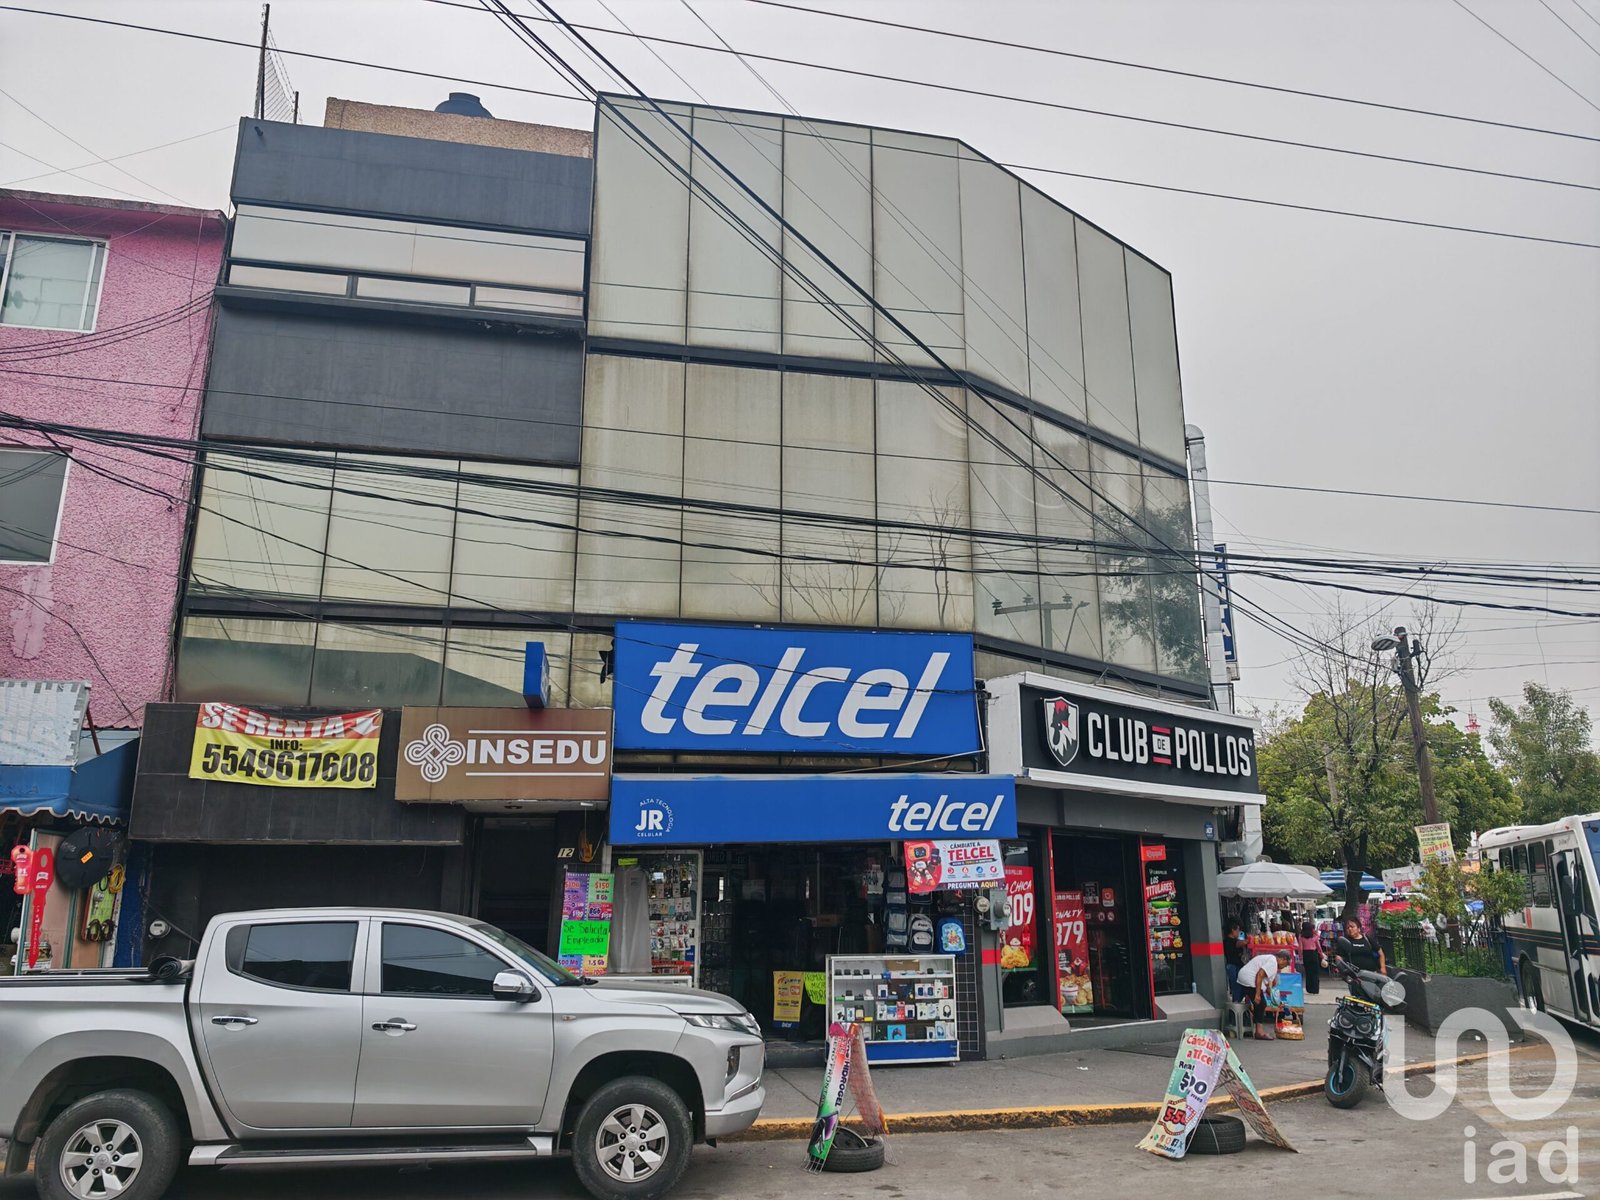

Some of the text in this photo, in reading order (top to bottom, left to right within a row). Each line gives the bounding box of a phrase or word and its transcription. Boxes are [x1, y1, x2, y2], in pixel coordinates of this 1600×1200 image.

[640, 643, 951, 738] telcel
[202, 702, 345, 738] SE RENTA
[270, 739, 303, 750] INFO:
[466, 739, 606, 764] INSEDU
[1087, 711, 1252, 777] CLUB DE POLLOS
[202, 743, 375, 782] 5549617608
[639, 798, 655, 807] ALTA
[634, 809, 664, 831] JR
[888, 794, 1004, 831] telcel
[561, 848, 573, 857] 12
[947, 846, 994, 861] TELCEL
[1423, 841, 1450, 855] CRISTAL
[947, 881, 979, 889] PREGUNTA
[1009, 880, 1032, 894] CHICA
[564, 922, 608, 936] Se Solicita
[834, 1060, 851, 1107] HIDROGEL
